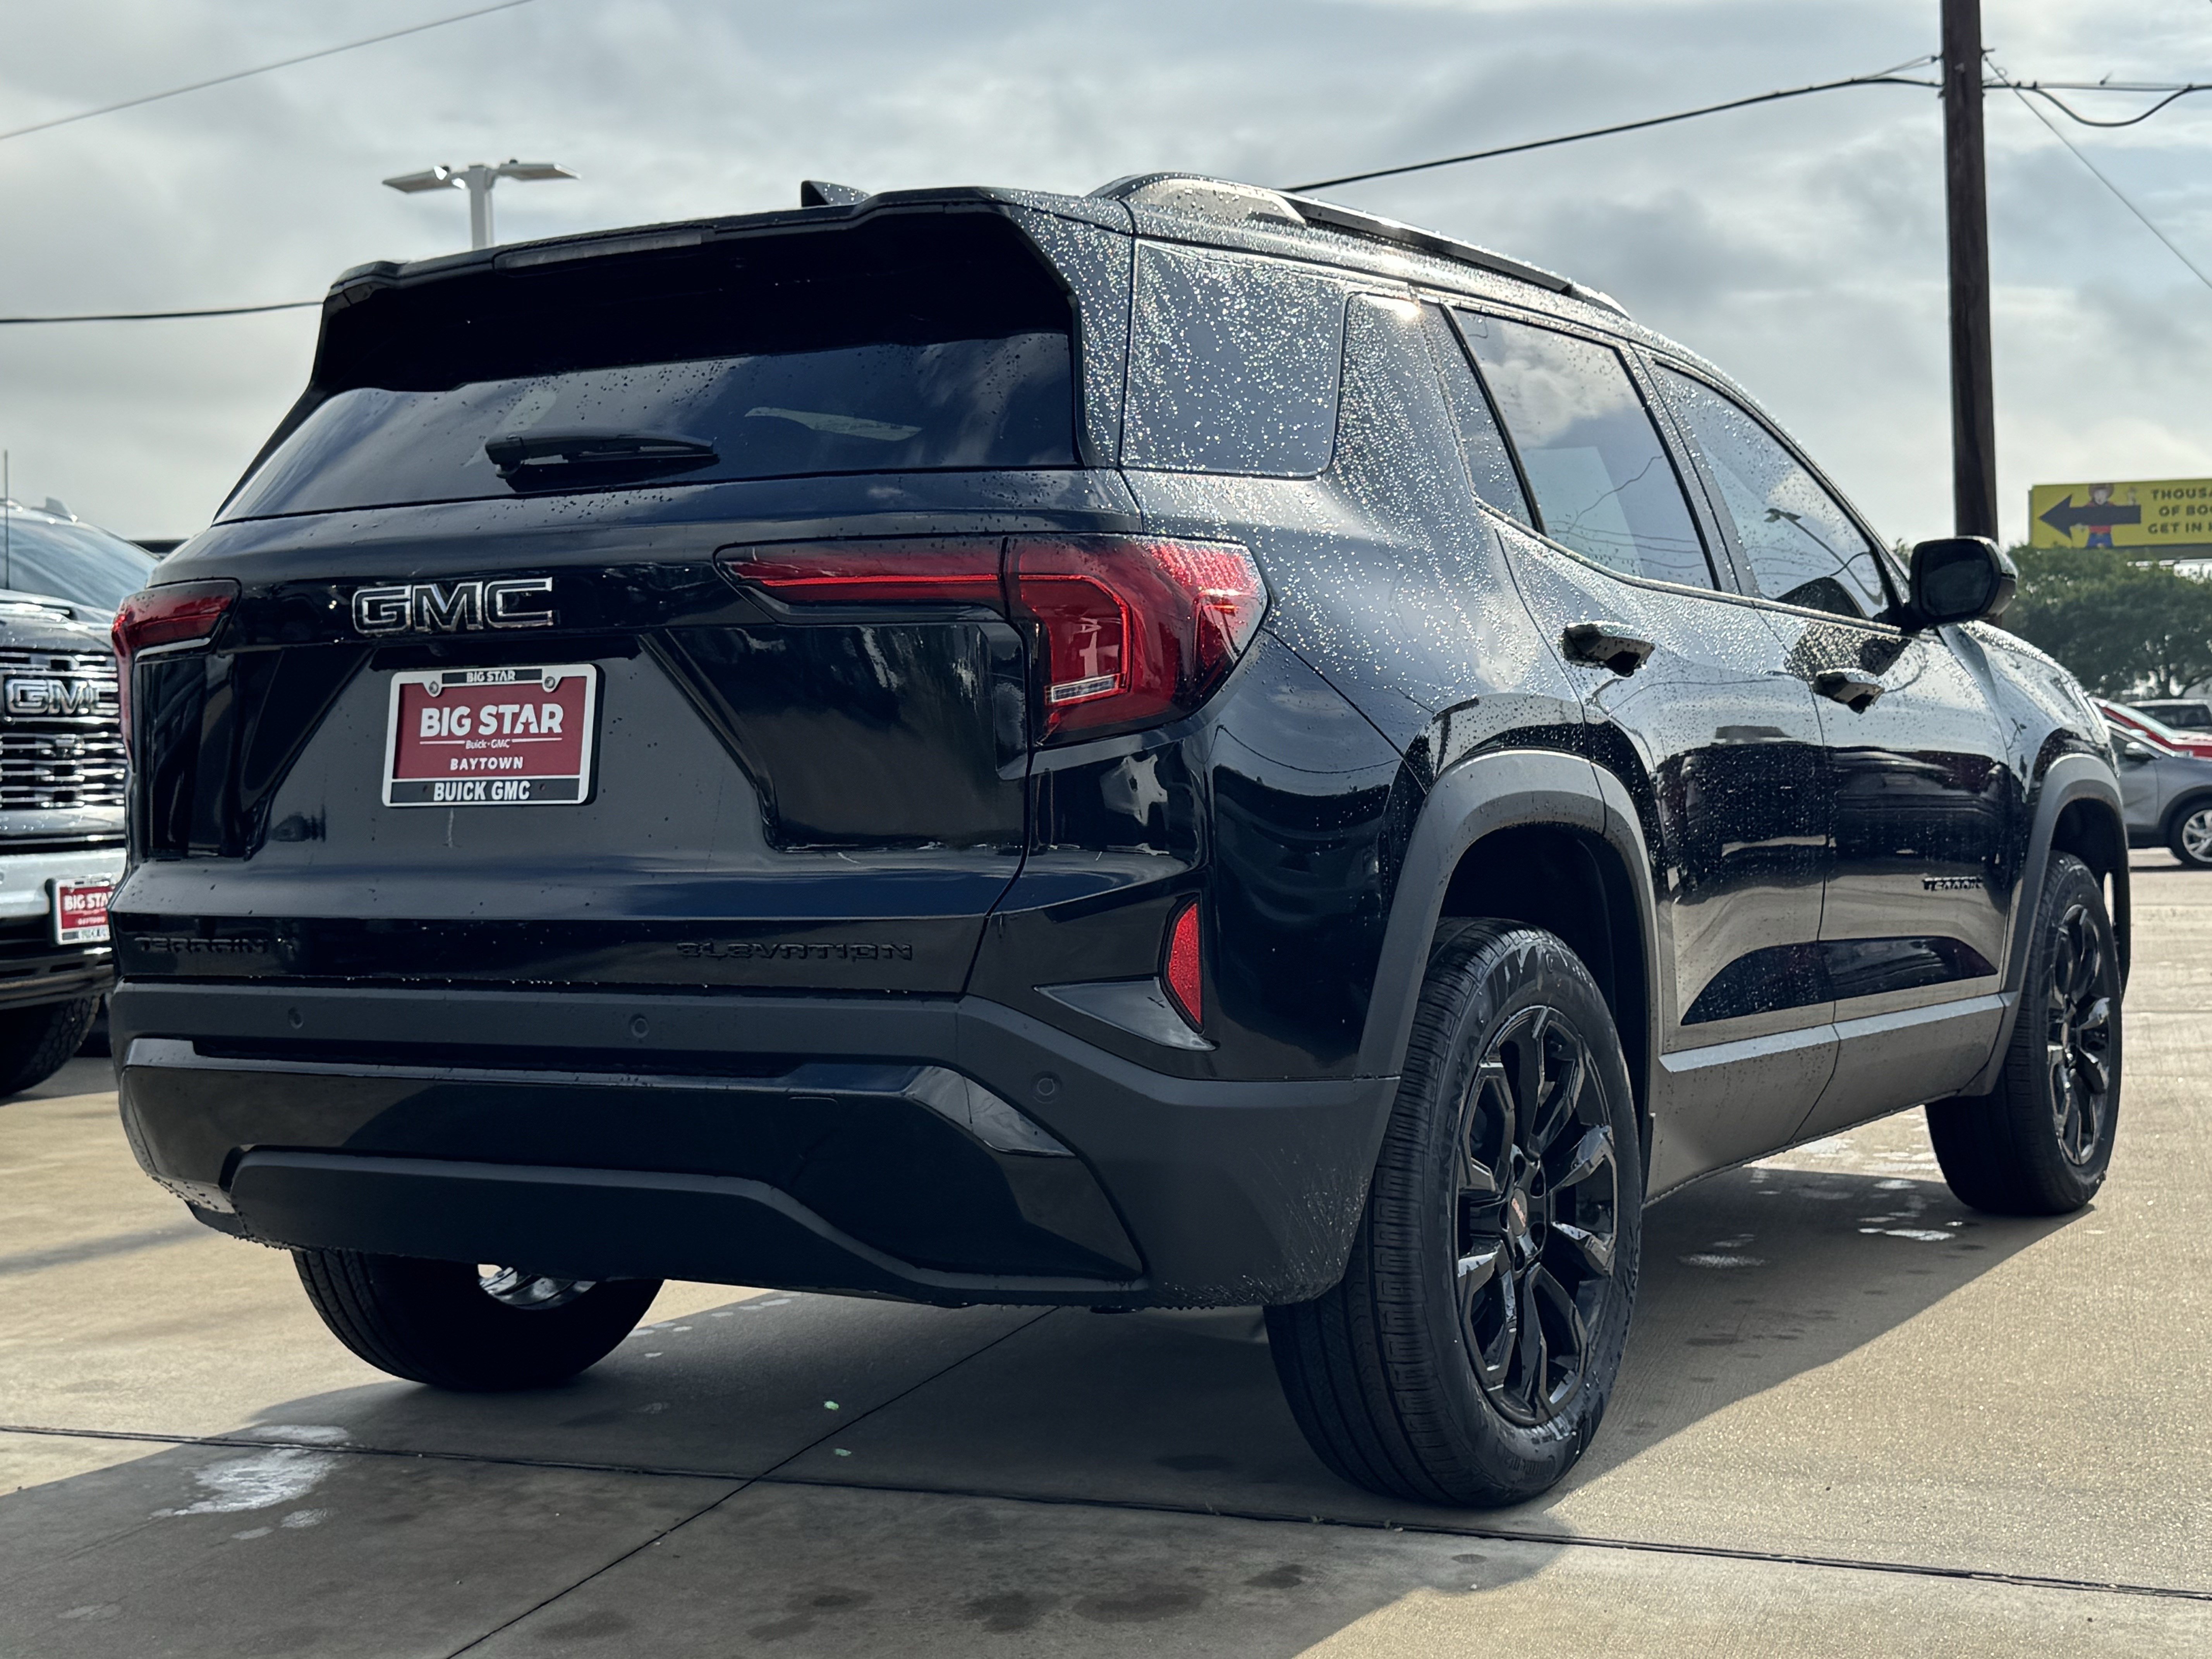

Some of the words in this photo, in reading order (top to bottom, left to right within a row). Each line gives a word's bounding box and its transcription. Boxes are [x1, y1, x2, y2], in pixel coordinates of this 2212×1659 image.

[2159, 505, 2180, 517] OF
[2148, 522, 2179, 534] GET
[2186, 522, 2202, 534] IN
[352, 577, 553, 634] GMC
[466, 672, 485, 682] BIG
[487, 670, 516, 682] STAR
[5, 678, 119, 716] GMC
[419, 706, 471, 737] BIG
[478, 703, 564, 736] STAR
[450, 756, 523, 771] BAYTOWN
[433, 782, 486, 801] BUICK
[491, 780, 531, 800] GMC
[64, 894, 86, 912] BIG
[676, 941, 913, 961] ELEVATION
